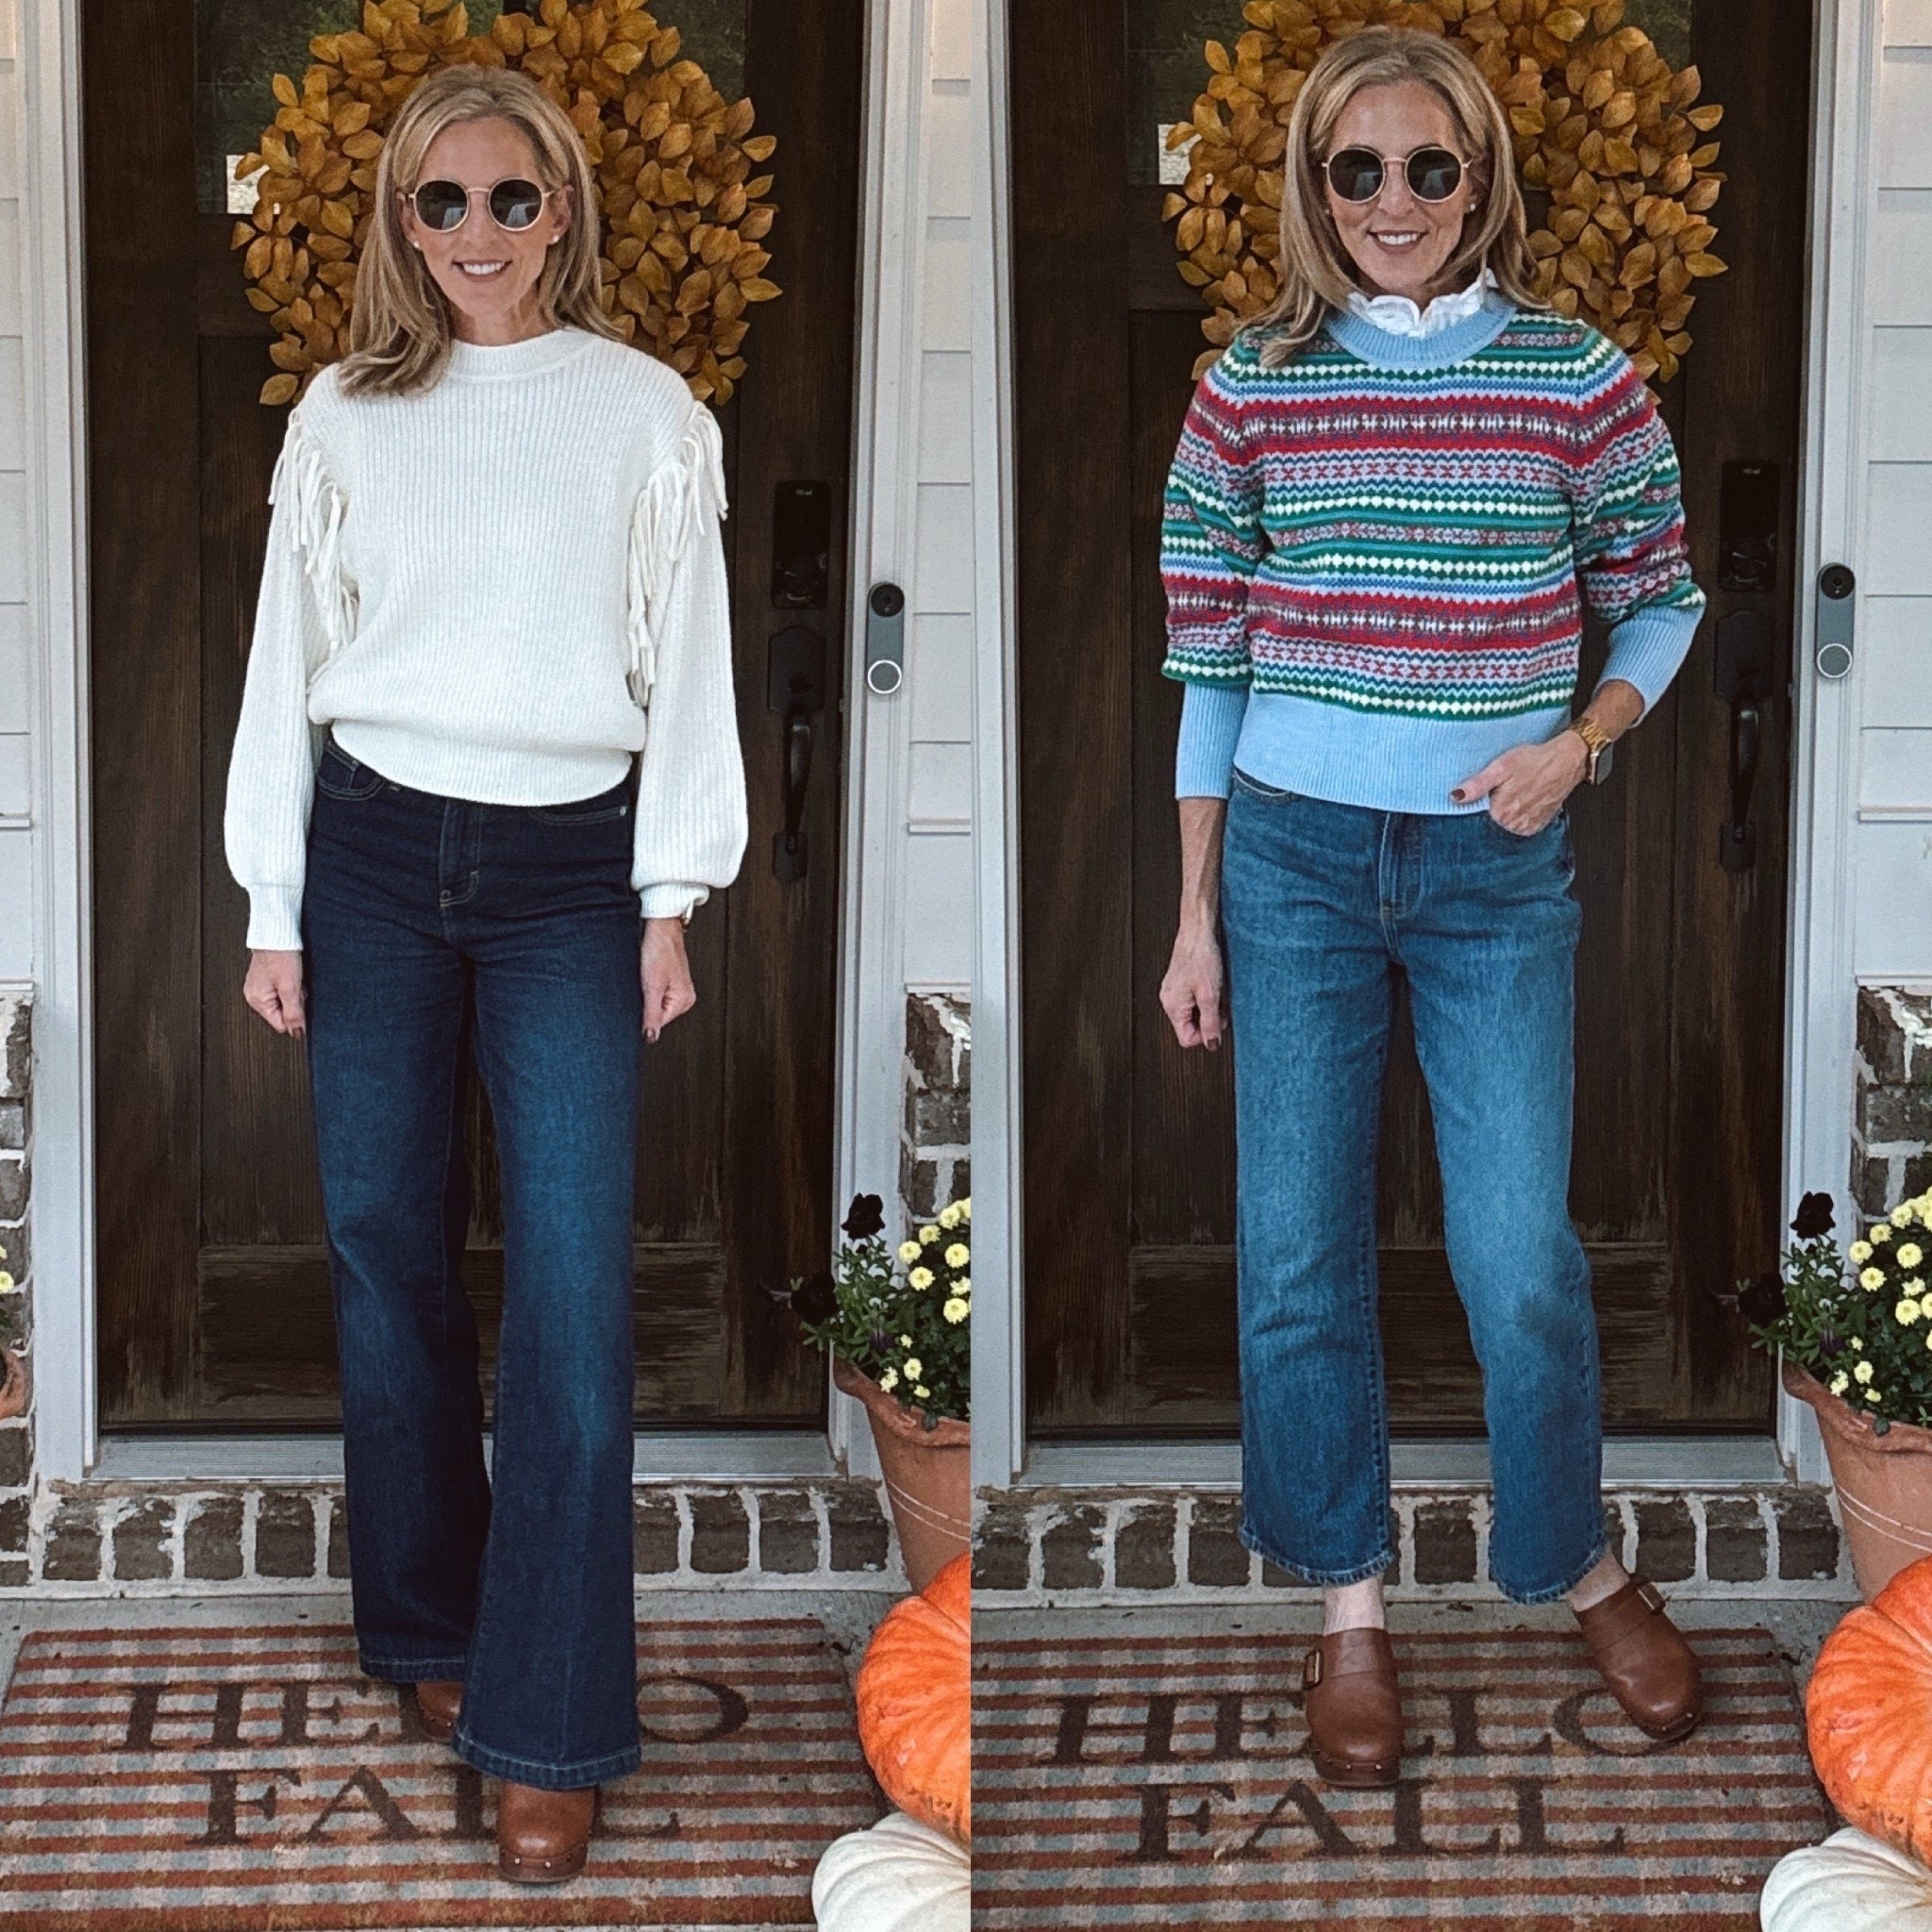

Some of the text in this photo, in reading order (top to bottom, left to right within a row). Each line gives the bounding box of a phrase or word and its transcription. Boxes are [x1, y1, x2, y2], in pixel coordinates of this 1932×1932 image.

[111, 1676, 750, 1749] HEO
[1036, 1687, 1690, 1765] HELO
[1115, 1775, 1624, 1860] FALL
